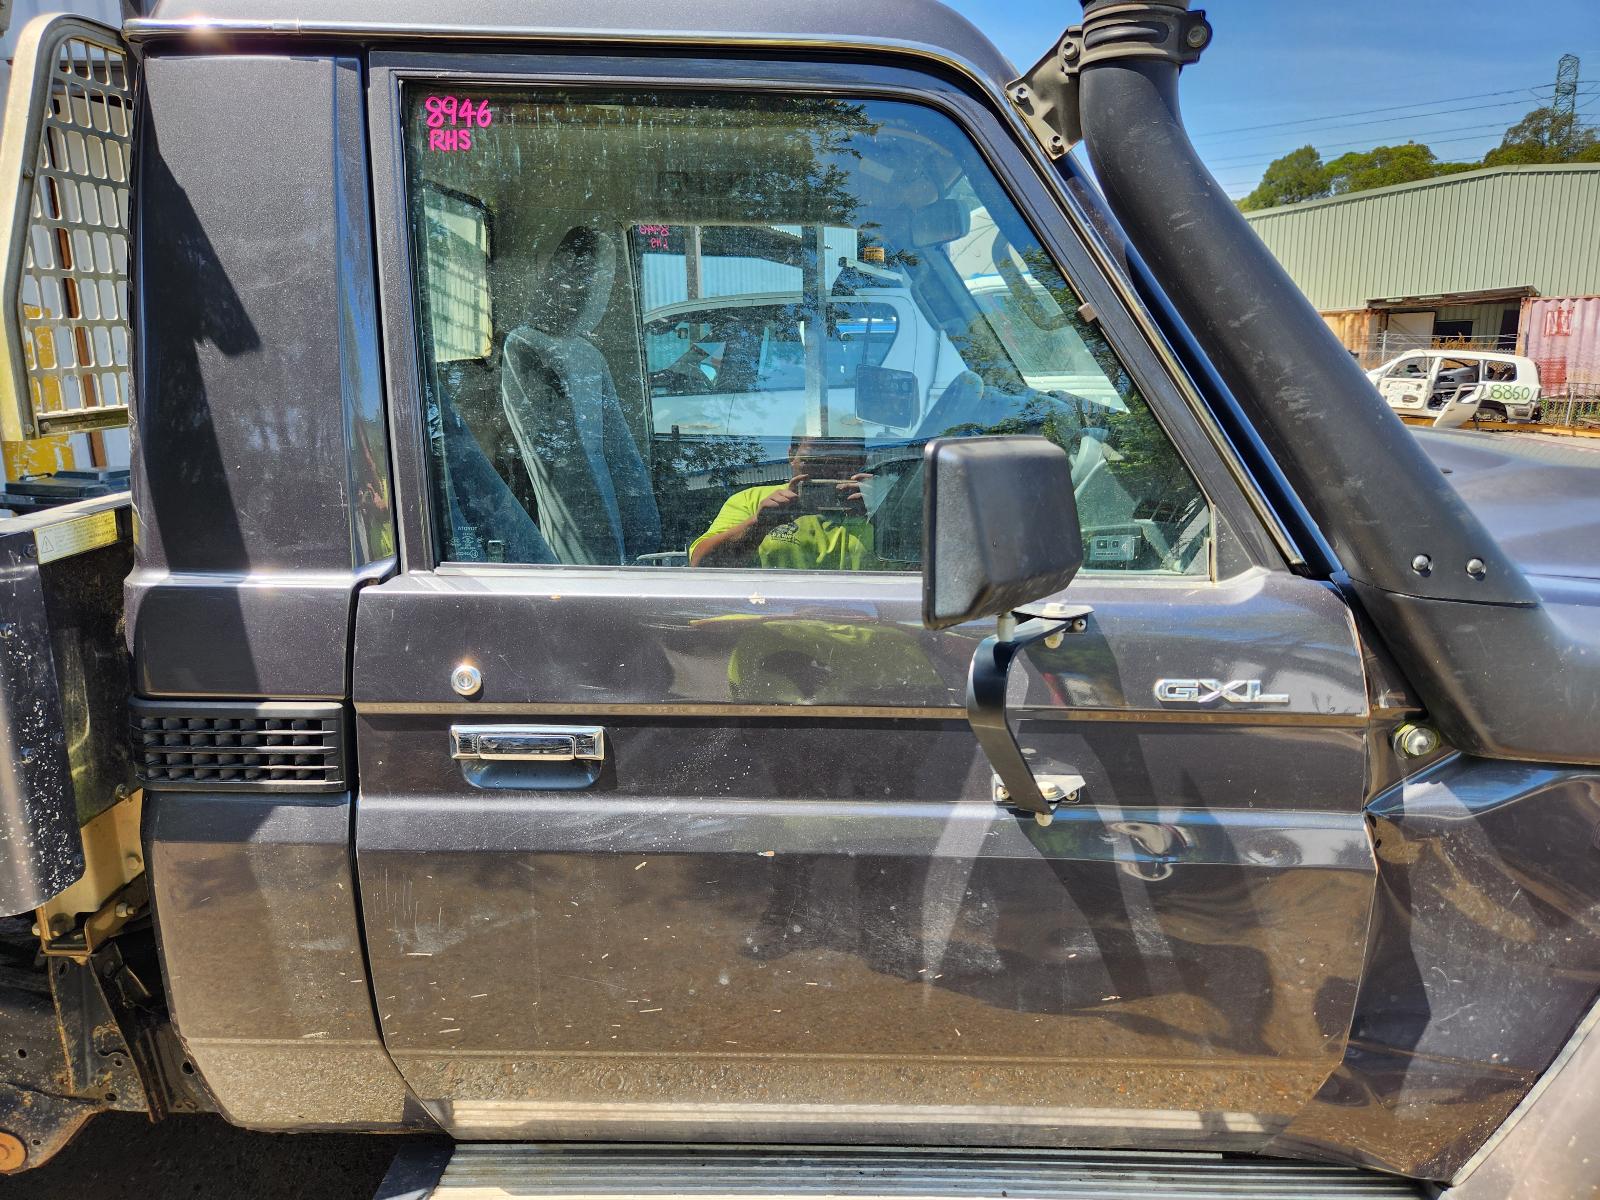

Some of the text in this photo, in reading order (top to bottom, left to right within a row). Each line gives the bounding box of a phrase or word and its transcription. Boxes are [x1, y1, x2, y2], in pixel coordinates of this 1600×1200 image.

[425, 96, 492, 128] 8946
[429, 128, 472, 152] RHS
[1490, 384, 1530, 400] 8860
[1153, 678, 1289, 704] GXL
